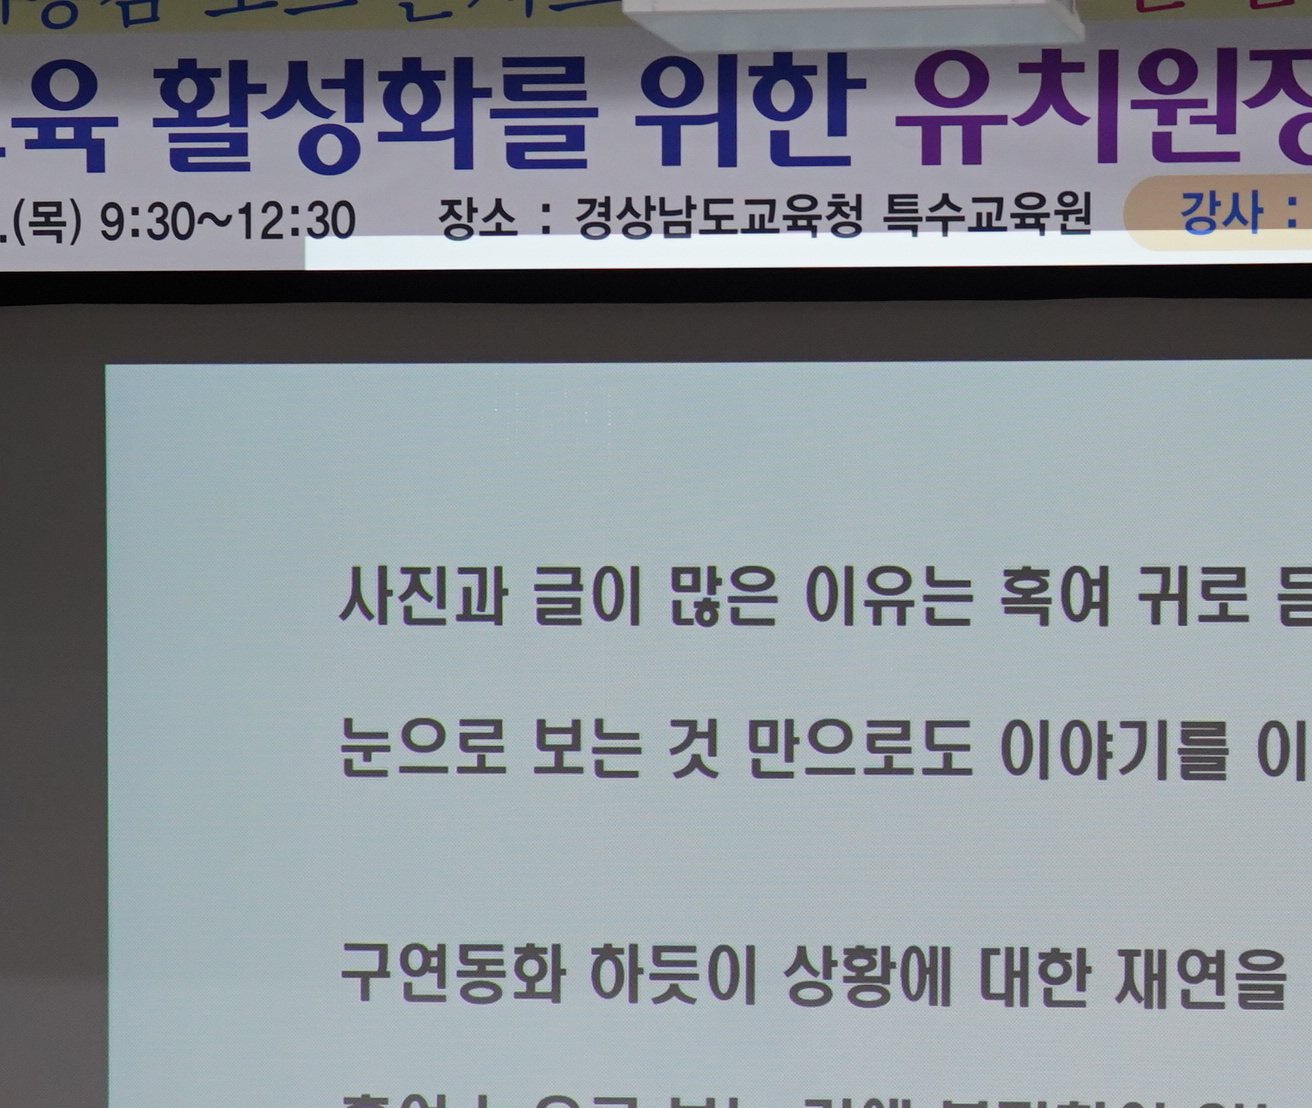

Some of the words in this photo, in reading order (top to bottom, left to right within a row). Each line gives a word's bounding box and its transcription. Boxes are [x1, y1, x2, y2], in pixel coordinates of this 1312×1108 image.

[152, 55, 599, 177] 활성화를
[634, 50, 868, 168] 위한
[100, 199, 356, 242] 9:30~12:30
[438, 196, 518, 242] 장소
[541, 203, 551, 235] :
[576, 193, 863, 241] 경상남도교육청
[882, 190, 1092, 238] 특수교육원
[1182, 189, 1264, 235] 강사
[1288, 196, 1297, 228] :
[339, 564, 510, 627] 사진과
[533, 565, 641, 627] 글이
[671, 564, 779, 628] 많은
[806, 565, 974, 627] 이유는
[1000, 565, 1110, 628] 혹여
[1138, 565, 1250, 627] 귀로
[340, 717, 507, 778] 눈으로
[533, 717, 643, 779] 보는
[669, 717, 720, 779] 것
[748, 718, 974, 779] 만으로도
[1001, 718, 1230, 781] 이야기를
[341, 942, 567, 1005] 구연동화
[591, 943, 756, 1006] 하듯이
[784, 944, 951, 1009] 상황에
[980, 946, 1093, 1008] 대한
[1115, 948, 1288, 1011] 재연을
